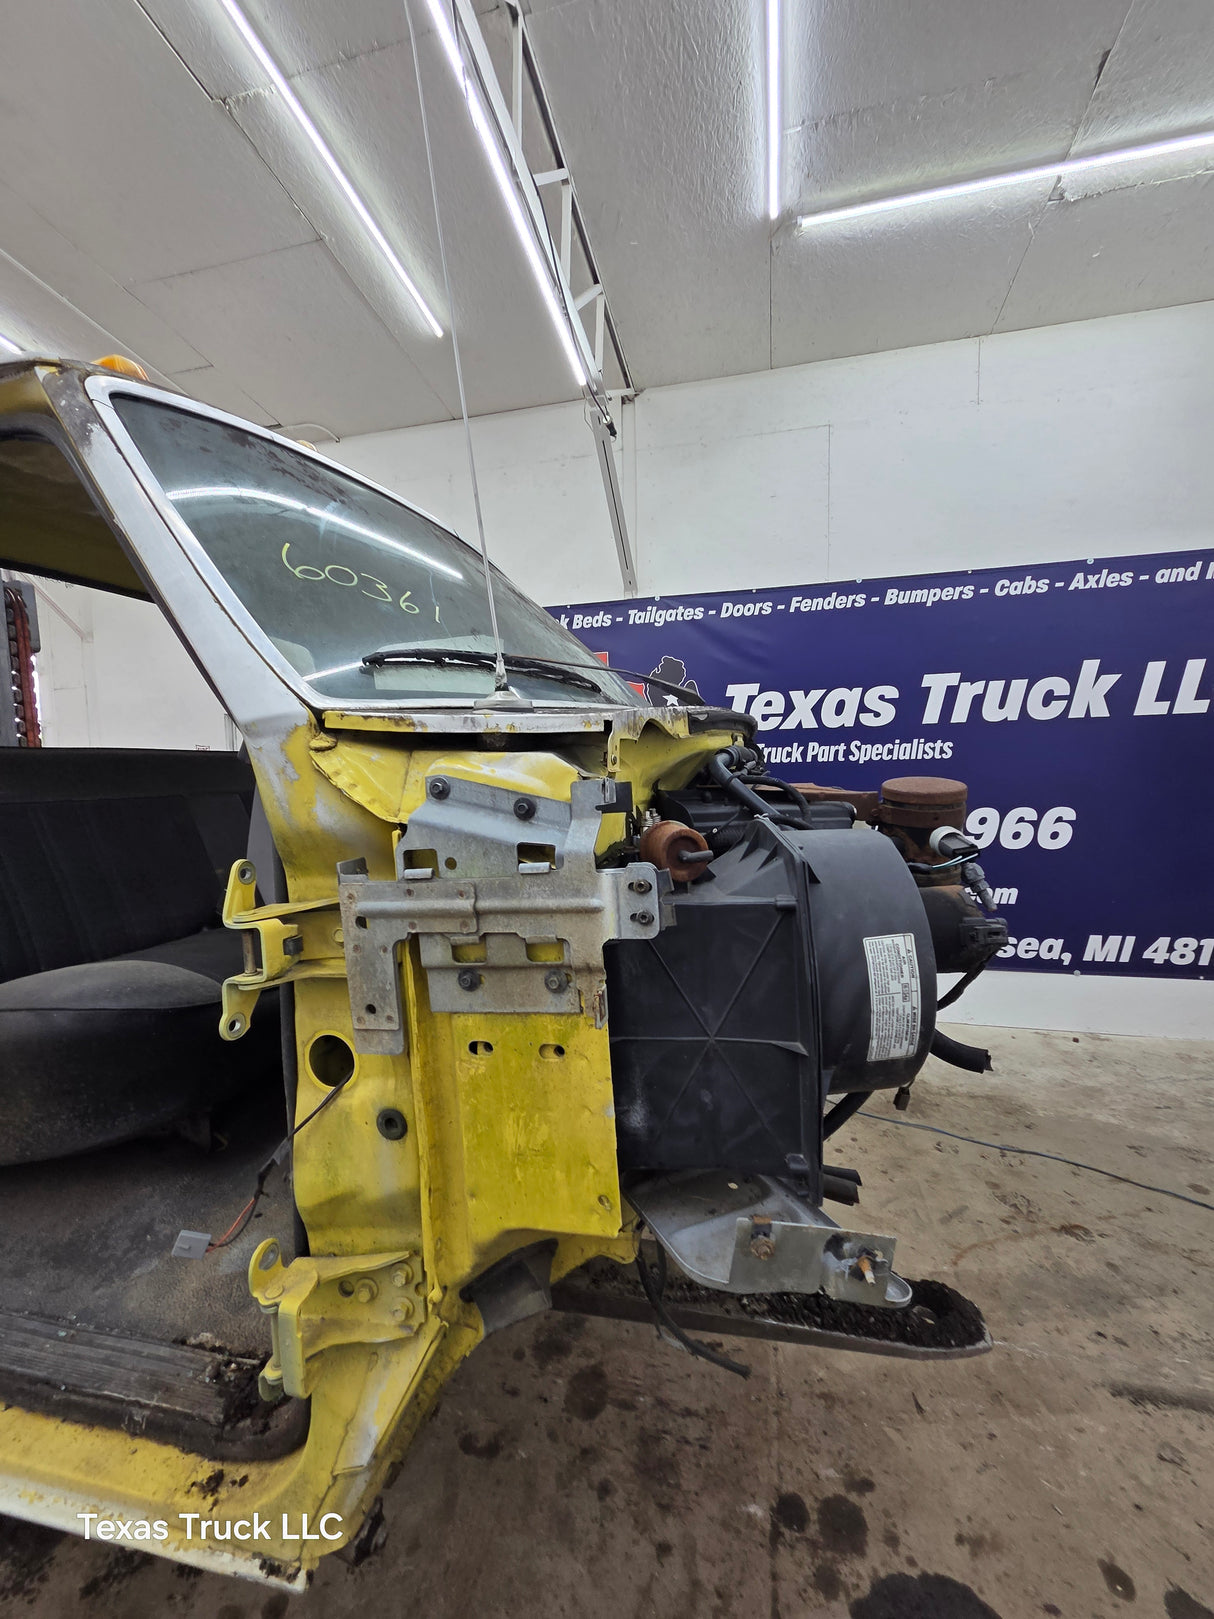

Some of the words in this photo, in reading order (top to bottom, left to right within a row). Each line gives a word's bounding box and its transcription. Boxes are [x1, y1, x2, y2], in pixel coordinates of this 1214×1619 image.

[281, 542, 441, 624] 60361
[572, 611, 613, 630] Beds
[628, 606, 705, 628] Tailgates
[720, 600, 774, 619] Doors
[789, 591, 867, 613] Fenders
[884, 584, 976, 607] Bumpers
[994, 575, 1051, 597] Cabs
[1068, 568, 1134, 591] Axles
[1155, 560, 1204, 584] and
[725, 683, 900, 732] Texas
[920, 658, 1123, 725] Truck
[806, 739, 847, 764] Part
[849, 738, 954, 764] Specialists
[964, 806, 1077, 850] 966
[1083, 934, 1137, 963] MI
